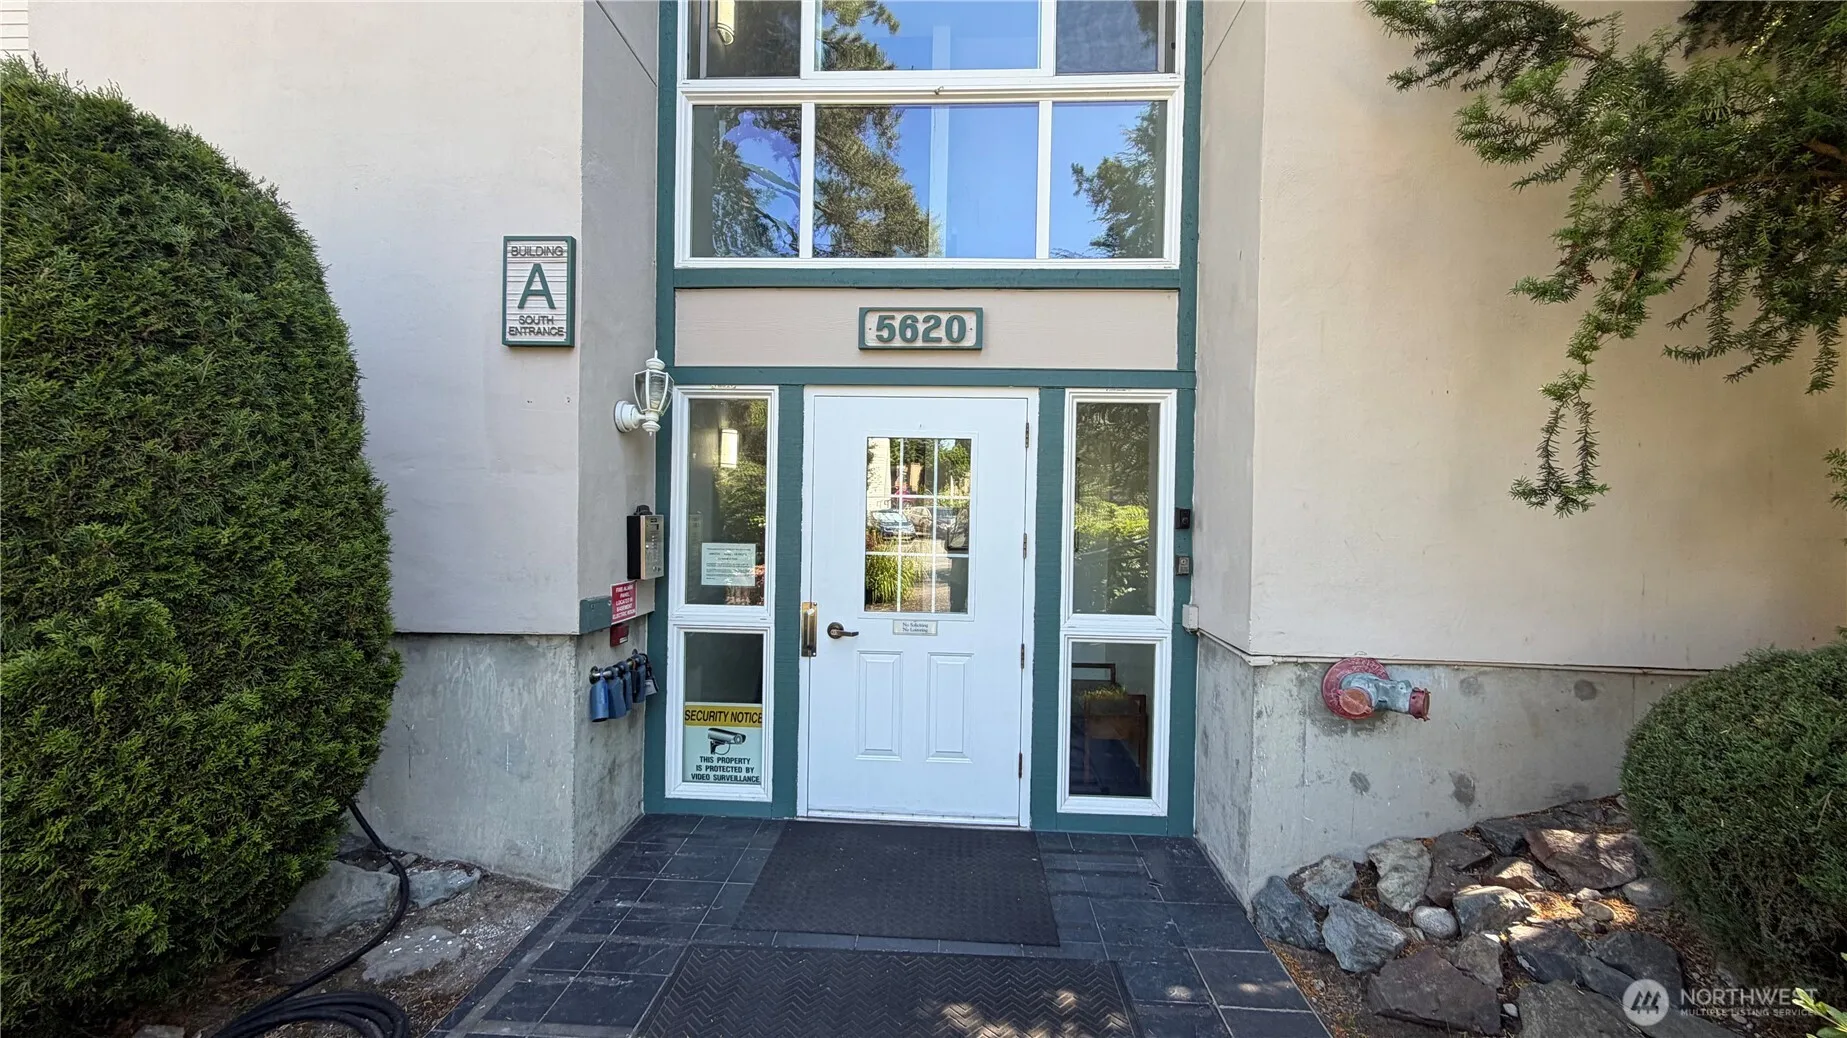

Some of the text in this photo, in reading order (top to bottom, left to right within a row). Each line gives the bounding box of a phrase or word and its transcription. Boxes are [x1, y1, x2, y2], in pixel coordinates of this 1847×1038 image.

[510, 246, 563, 257] BUILDING
[517, 263, 556, 310] A
[518, 315, 554, 325] SOUTH
[508, 326, 565, 336] ENTRANCE
[876, 314, 966, 343] 5620
[685, 710, 762, 724] SECURITY NOTICE
[700, 756, 751, 765] THIS PROPERTY
[705, 765, 743, 773] PROTECTED
[691, 773, 760, 783] VIDEO SURVEILLANCE
